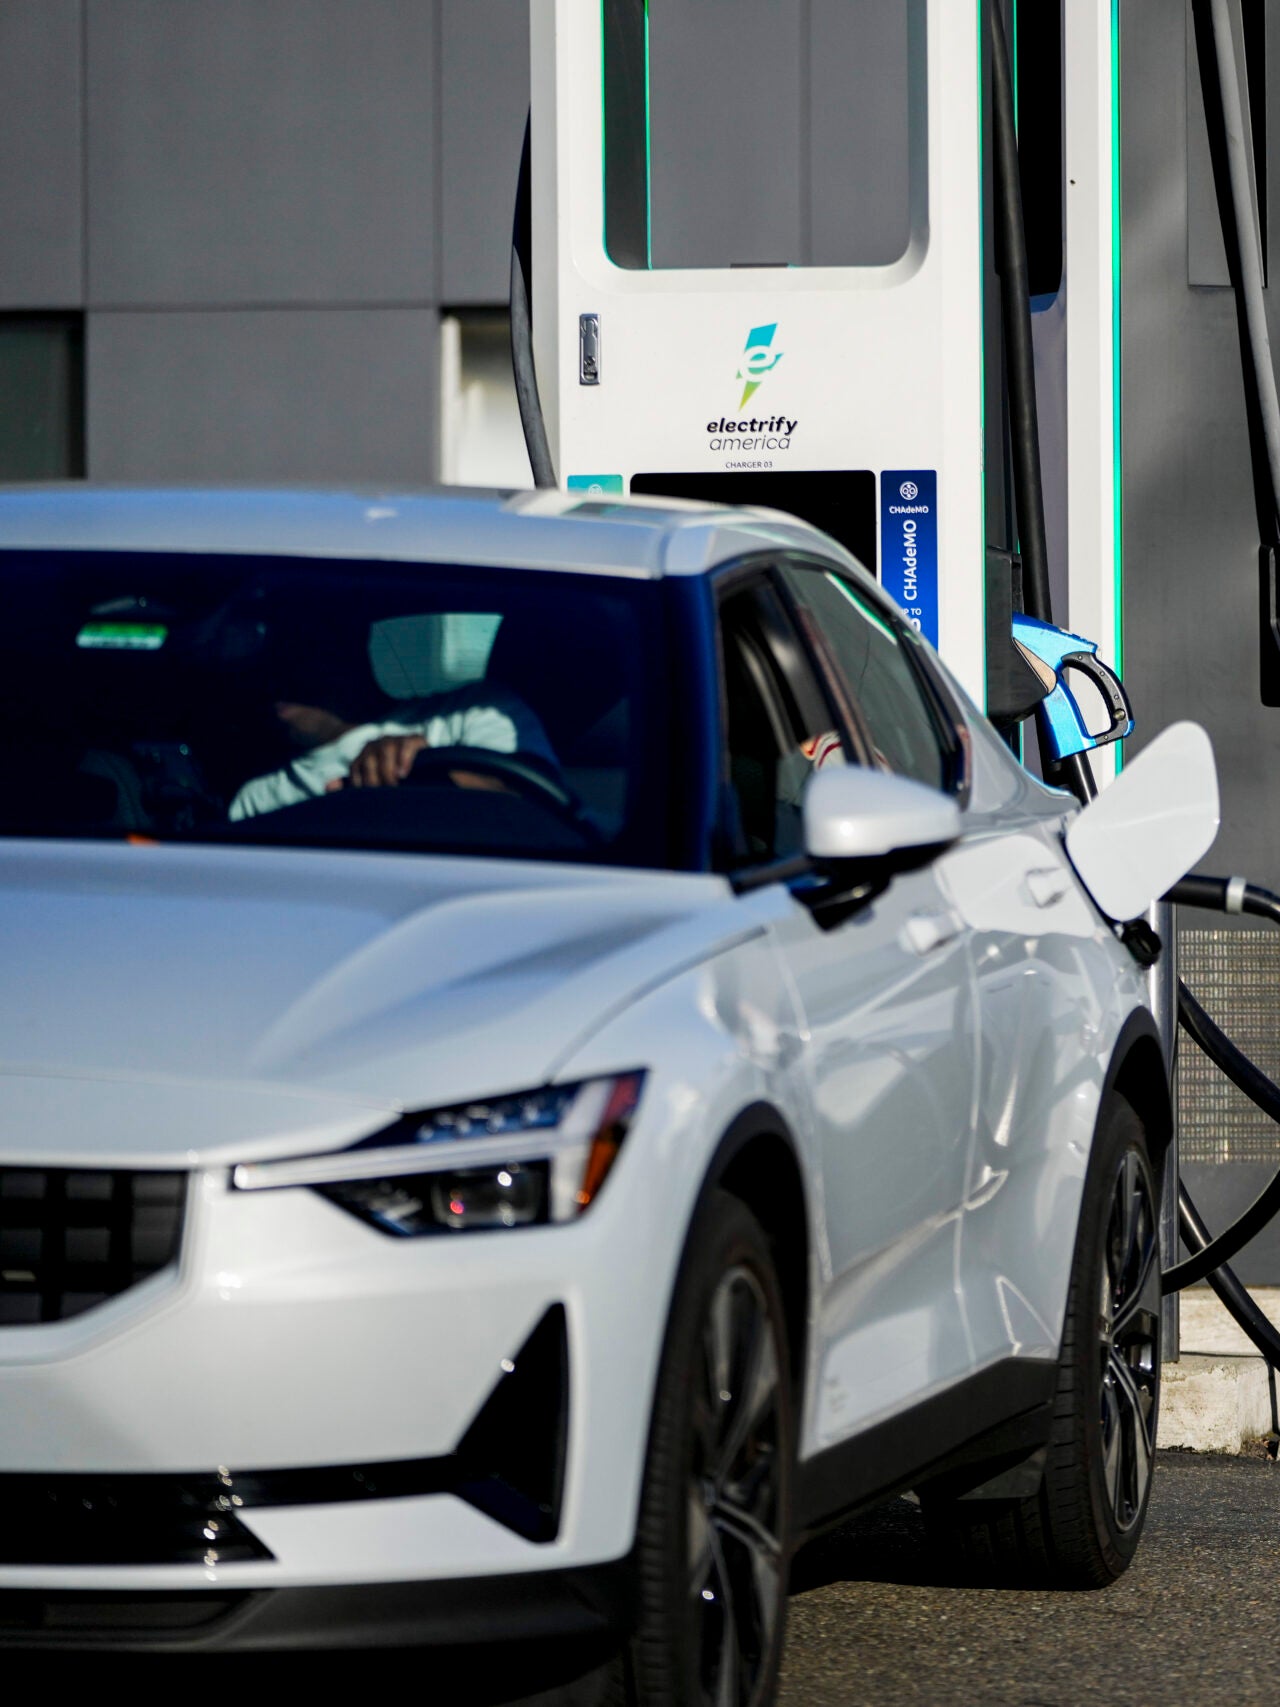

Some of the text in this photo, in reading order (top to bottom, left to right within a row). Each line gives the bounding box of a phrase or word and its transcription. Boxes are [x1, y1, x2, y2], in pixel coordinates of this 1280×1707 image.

[706, 416, 798, 436] electrify
[709, 435, 791, 451] america
[725, 461, 773, 469] CHARGER 03
[888, 505, 929, 514] CHAdeMO
[902, 519, 918, 601] CHAdeMO
[911, 608, 922, 616] TO
